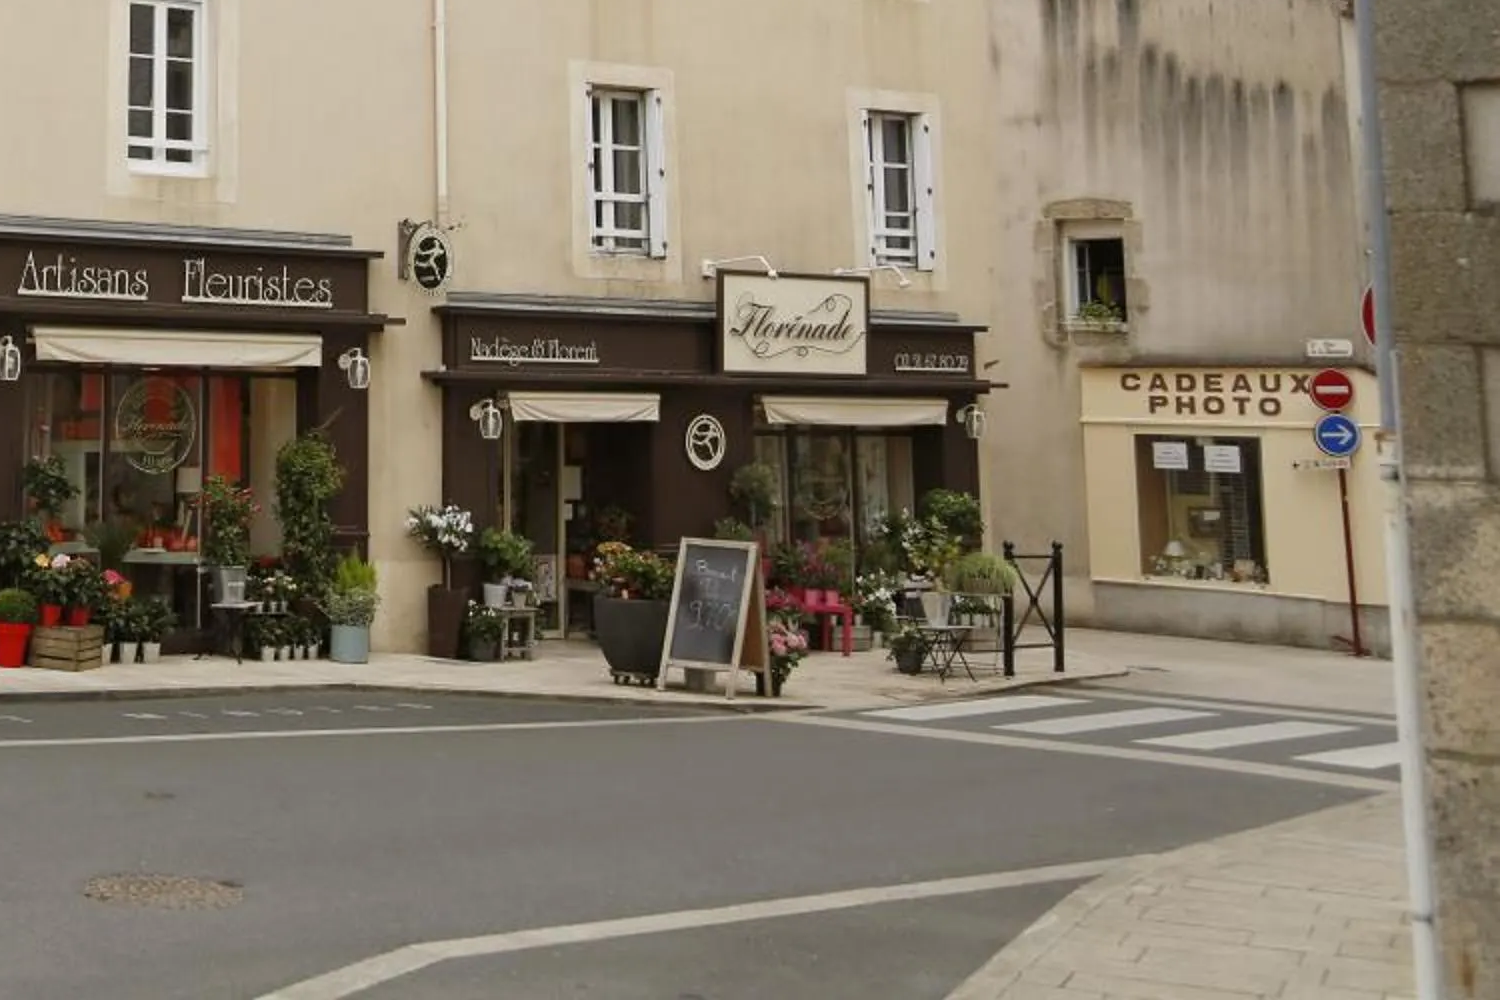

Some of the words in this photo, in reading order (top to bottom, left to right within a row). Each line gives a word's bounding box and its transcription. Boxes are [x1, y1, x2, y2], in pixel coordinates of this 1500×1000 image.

[18, 250, 148, 298] Artisans
[182, 256, 332, 306] Fleuristes
[730, 293, 856, 343] Florénade
[1120, 373, 1311, 393] CADEAUX
[1148, 396, 1282, 416] PHOTO
